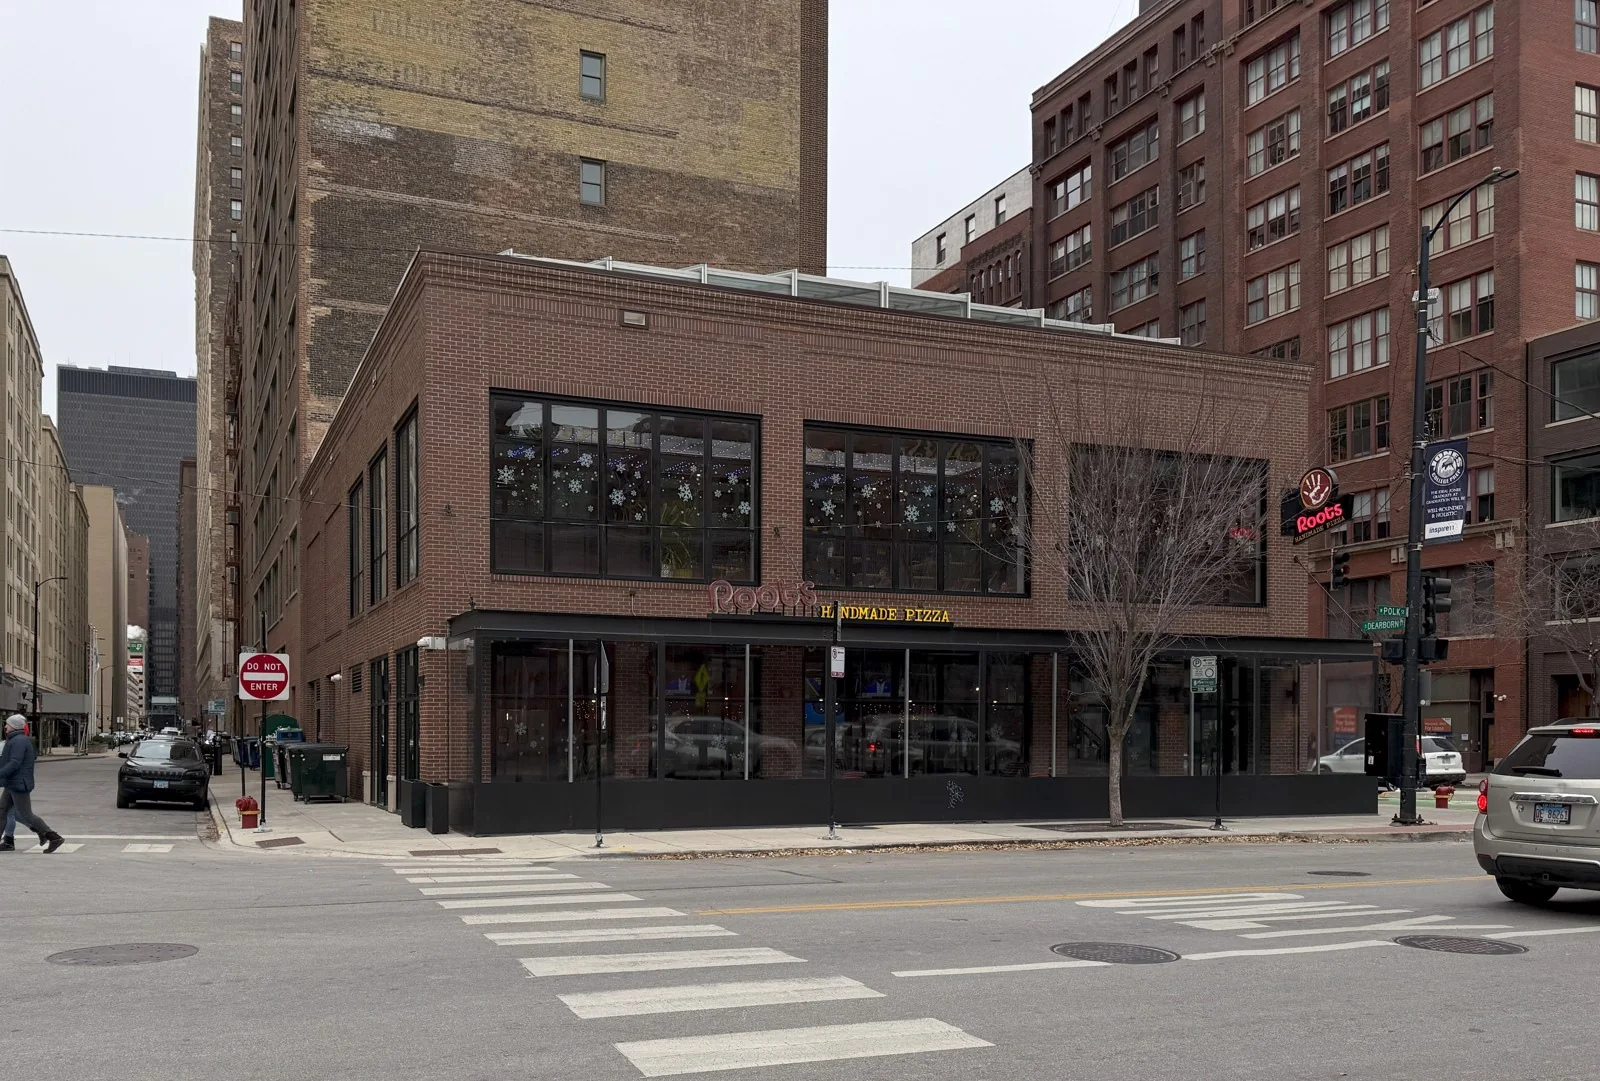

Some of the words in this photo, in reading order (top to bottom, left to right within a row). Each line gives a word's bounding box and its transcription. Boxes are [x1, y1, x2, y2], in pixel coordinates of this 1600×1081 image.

[1431, 450, 1463, 471] JONES
[1431, 472, 1449, 484] COLLEGE
[1450, 469, 1461, 482] PREP
[1296, 503, 1343, 533] Roots
[1294, 526, 1324, 543] HANDMADE
[1326, 516, 1346, 529] PIZZA
[708, 579, 817, 613] Roots
[904, 608, 950, 623] PIZZA
[1383, 606, 1400, 616] POLK
[1368, 620, 1399, 630] DEARBORN
[247, 662, 259, 670] DO
[264, 663, 282, 671] NOT
